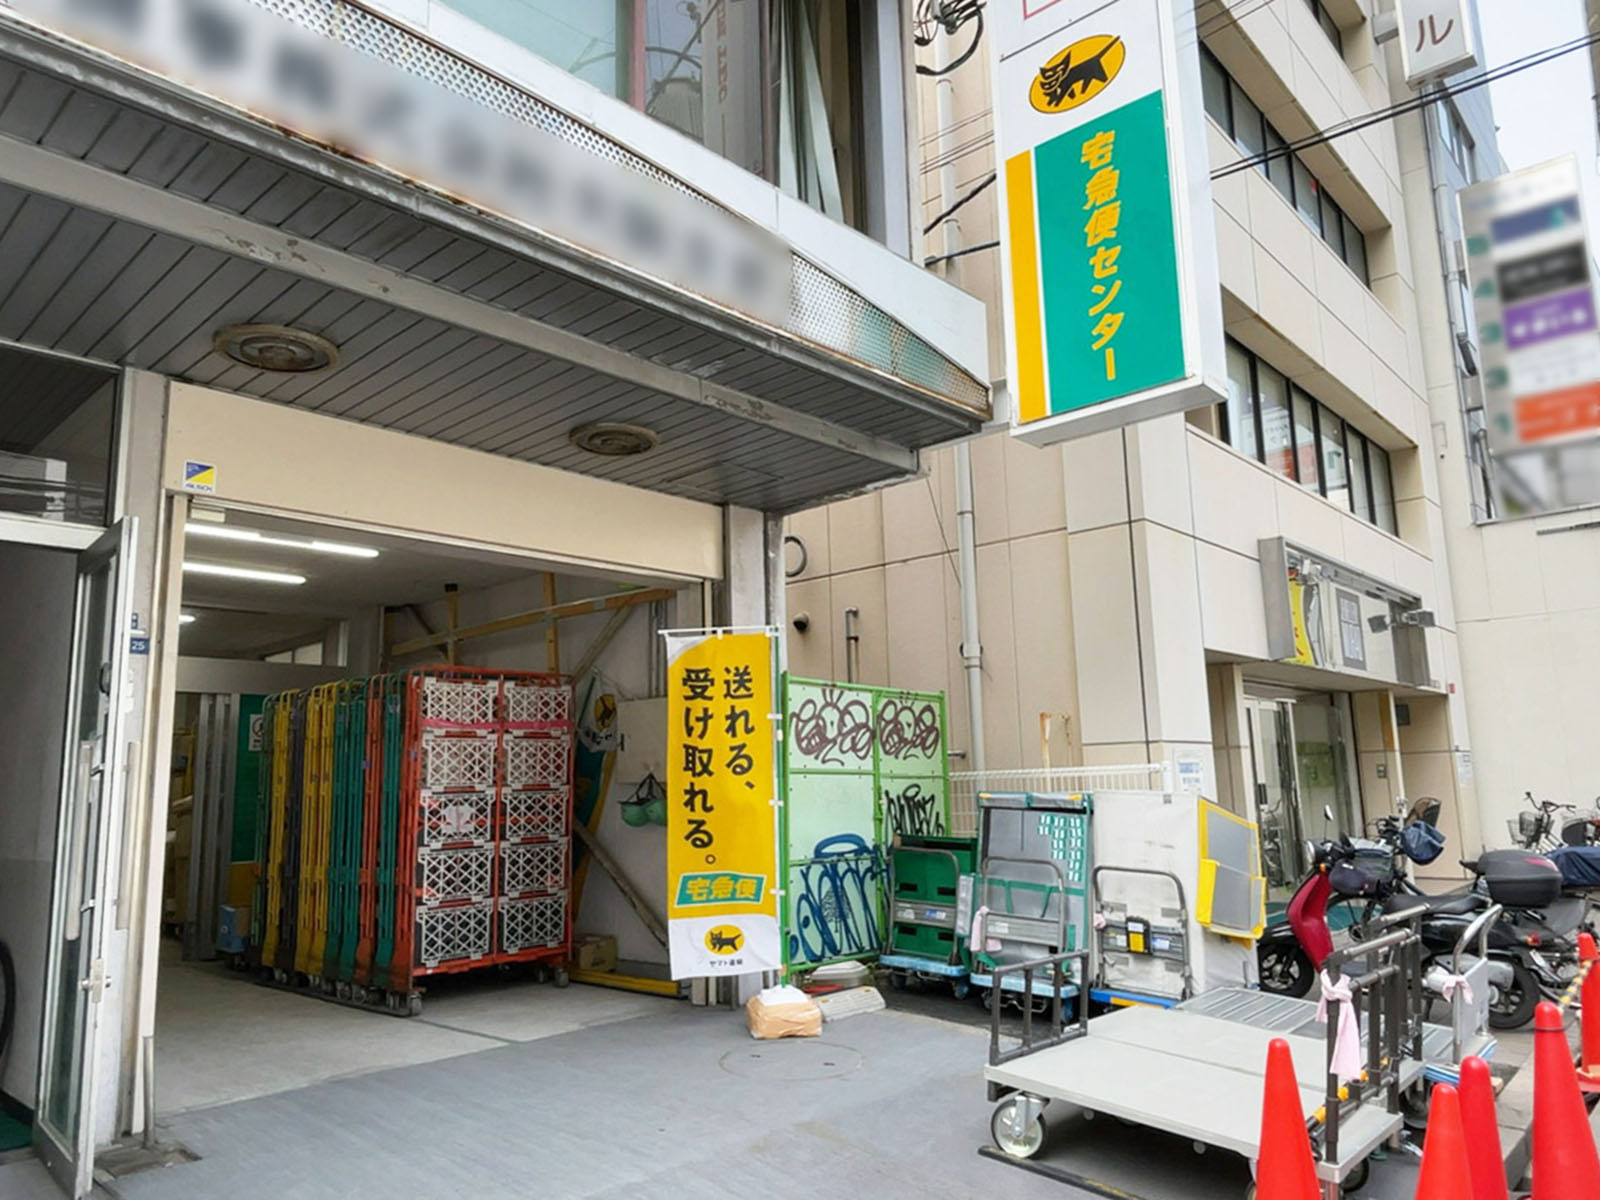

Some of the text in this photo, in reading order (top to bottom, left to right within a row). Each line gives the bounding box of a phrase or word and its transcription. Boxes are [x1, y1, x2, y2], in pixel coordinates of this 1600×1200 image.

[1416, 14, 1454, 52] ル
[1080, 130, 1125, 381] 宅急便センター
[131, 640, 146, 651] 25
[682, 667, 717, 865] 受け取れる。
[723, 665, 756, 789] 送れる、
[686, 875, 758, 901] 宅急便
